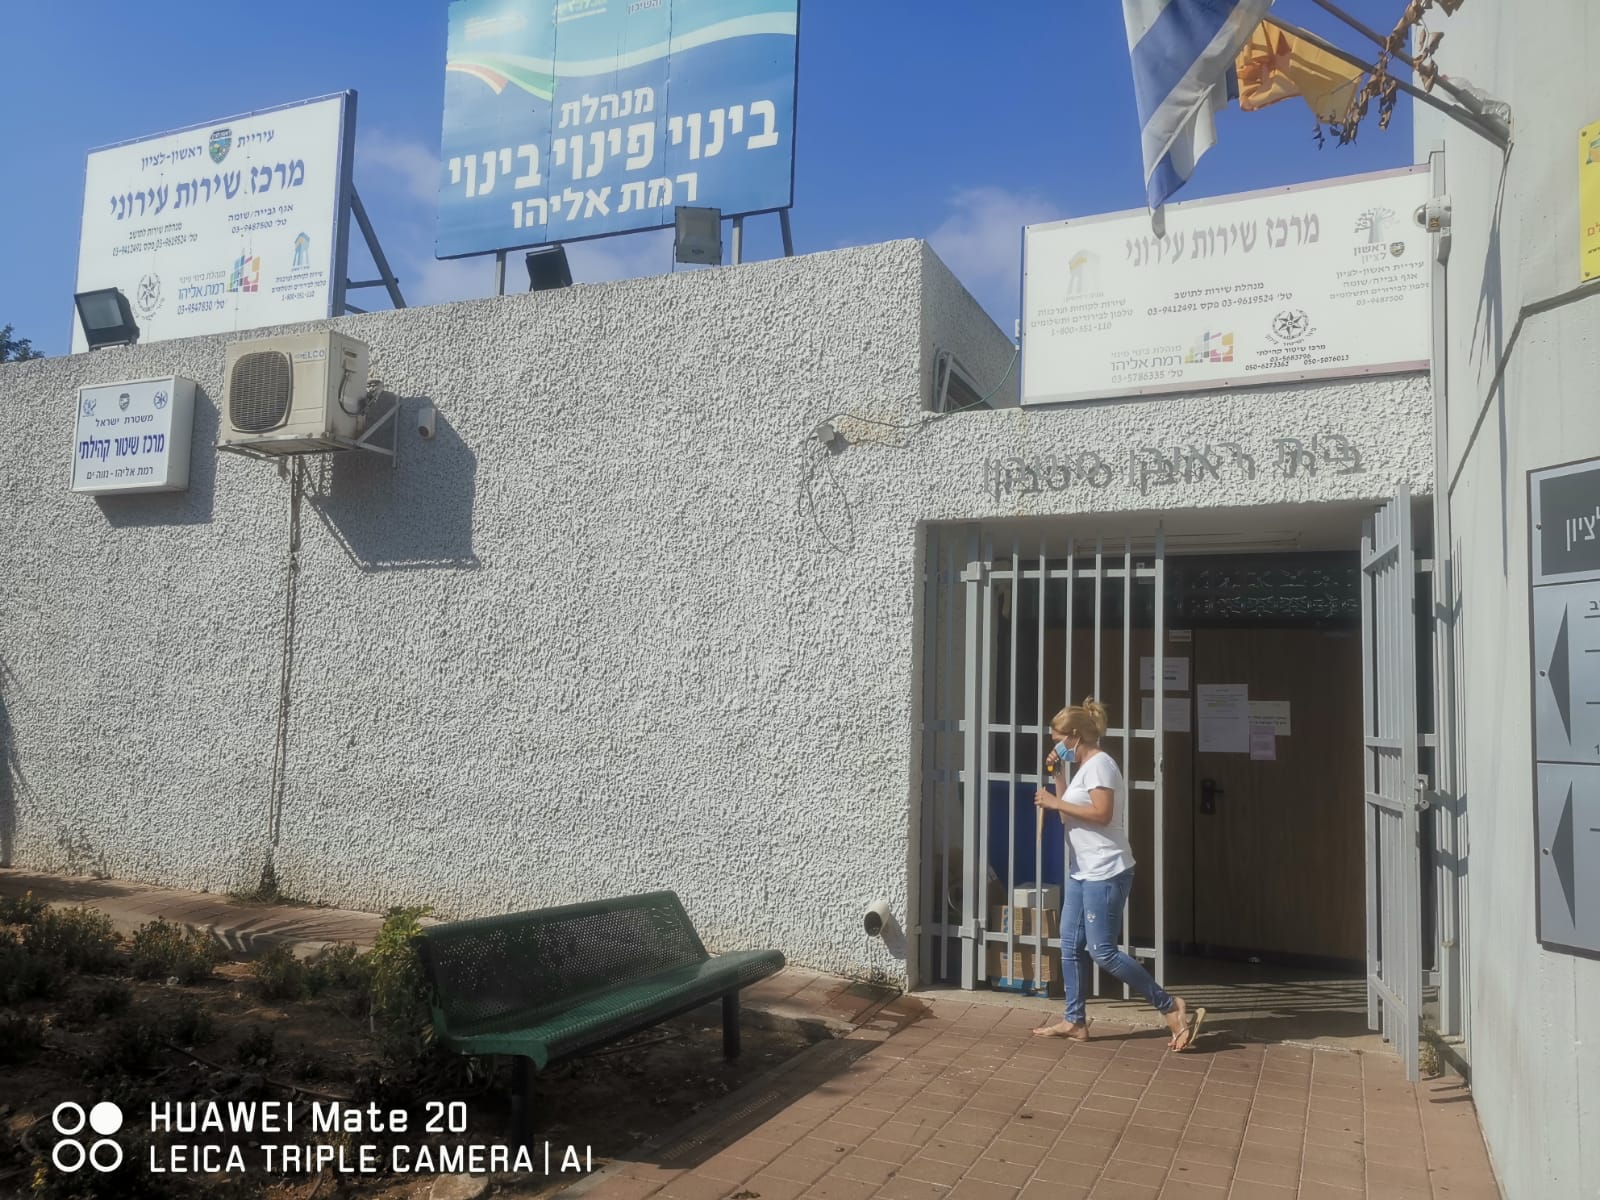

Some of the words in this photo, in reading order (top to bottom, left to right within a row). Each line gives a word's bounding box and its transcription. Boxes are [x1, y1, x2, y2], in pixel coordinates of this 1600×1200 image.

[558, 86, 654, 129] מנהלת
[236, 129, 275, 148] עיריית
[668, 99, 779, 160] בינוי
[141, 145, 203, 171] ראשון-לציון
[552, 122, 656, 180] פינוי
[251, 159, 305, 195] מרכז
[448, 144, 542, 198] בינוי
[173, 169, 242, 209] שירות
[617, 172, 698, 213] רמת
[110, 183, 169, 221] עירוני
[511, 186, 611, 229] אליהו
[1190, 219, 1258, 260] שירות
[1265, 211, 1321, 248] מרכז
[1125, 231, 1185, 268] עירוני
[1353, 243, 1387, 257] ראשון
[1361, 252, 1387, 265] לציון
[1393, 261, 1425, 271] עיריית
[178, 283, 203, 300] אליהו
[203, 282, 225, 297] רמת
[1174, 289, 1203, 300] לתושב
[1204, 285, 1233, 296] שירות
[1234, 281, 1265, 293] מנהלת
[1147, 303, 1198, 316] 03-9412491
[1200, 301, 1220, 311] פקס
[1221, 293, 1274, 308] 03-9619524
[1110, 356, 1149, 372] אליהו
[1151, 354, 1182, 368] רמת
[95, 416, 120, 428] ישראל
[124, 413, 154, 425] משטרת
[78, 434, 111, 463] קהילתי
[114, 436, 140, 457] שיטור
[142, 433, 165, 454] מרכז
[1272, 433, 1363, 474] בית
[114, 466, 136, 478] אליהו
[136, 465, 154, 476] רמת
[1129, 442, 1250, 493] ראובן
